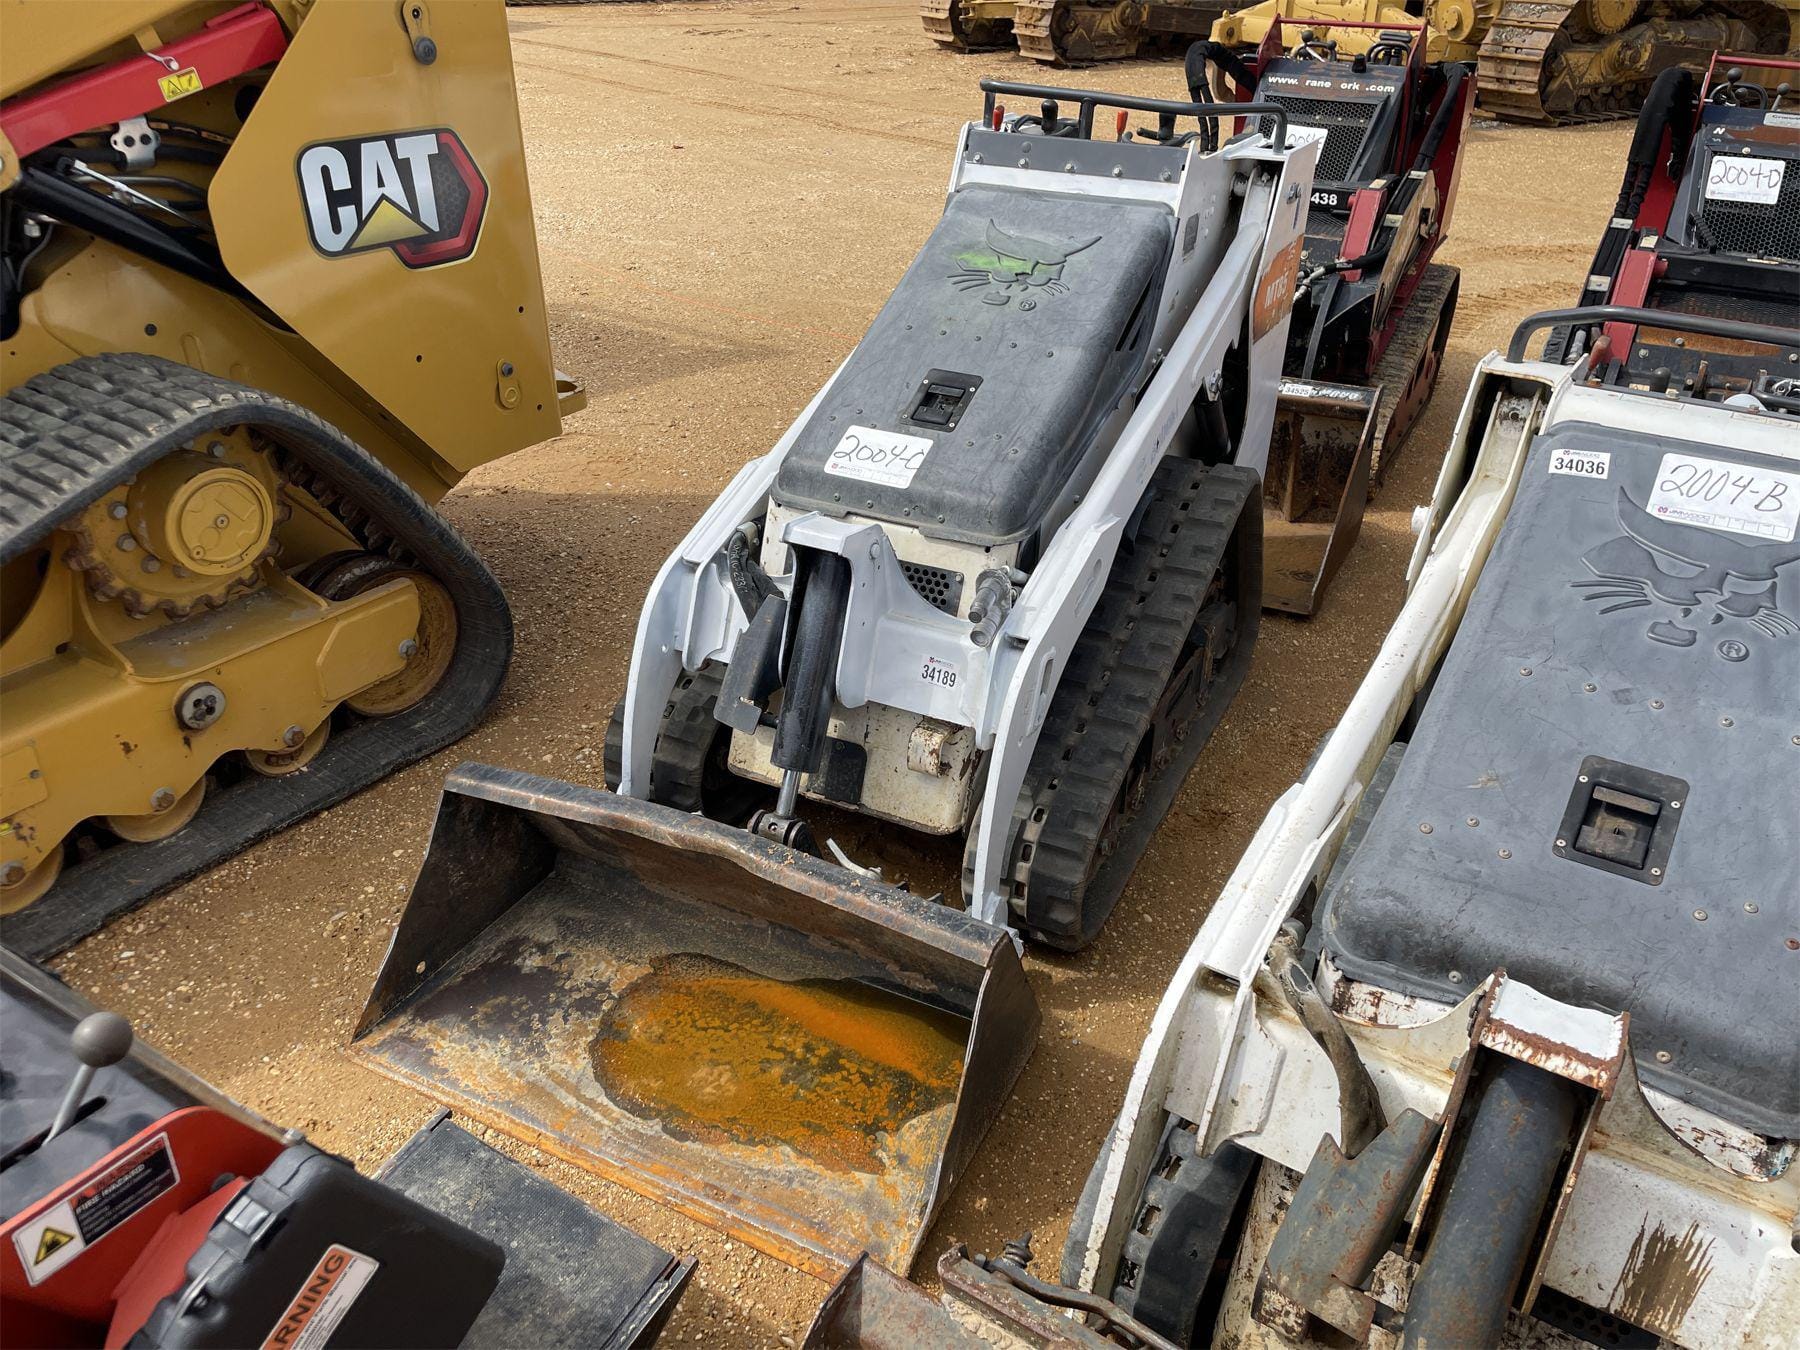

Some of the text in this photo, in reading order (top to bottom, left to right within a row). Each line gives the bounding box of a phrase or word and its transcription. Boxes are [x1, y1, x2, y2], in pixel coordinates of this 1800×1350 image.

[1710, 159, 1781, 189] 2004-D
[300, 134, 440, 252] CAT
[834, 434, 925, 470] 2004-C
[1554, 456, 1605, 476] 34036
[1659, 464, 1789, 512] 2004-B
[921, 664, 957, 688] 34189
[274, 1253, 345, 1350] RNING
